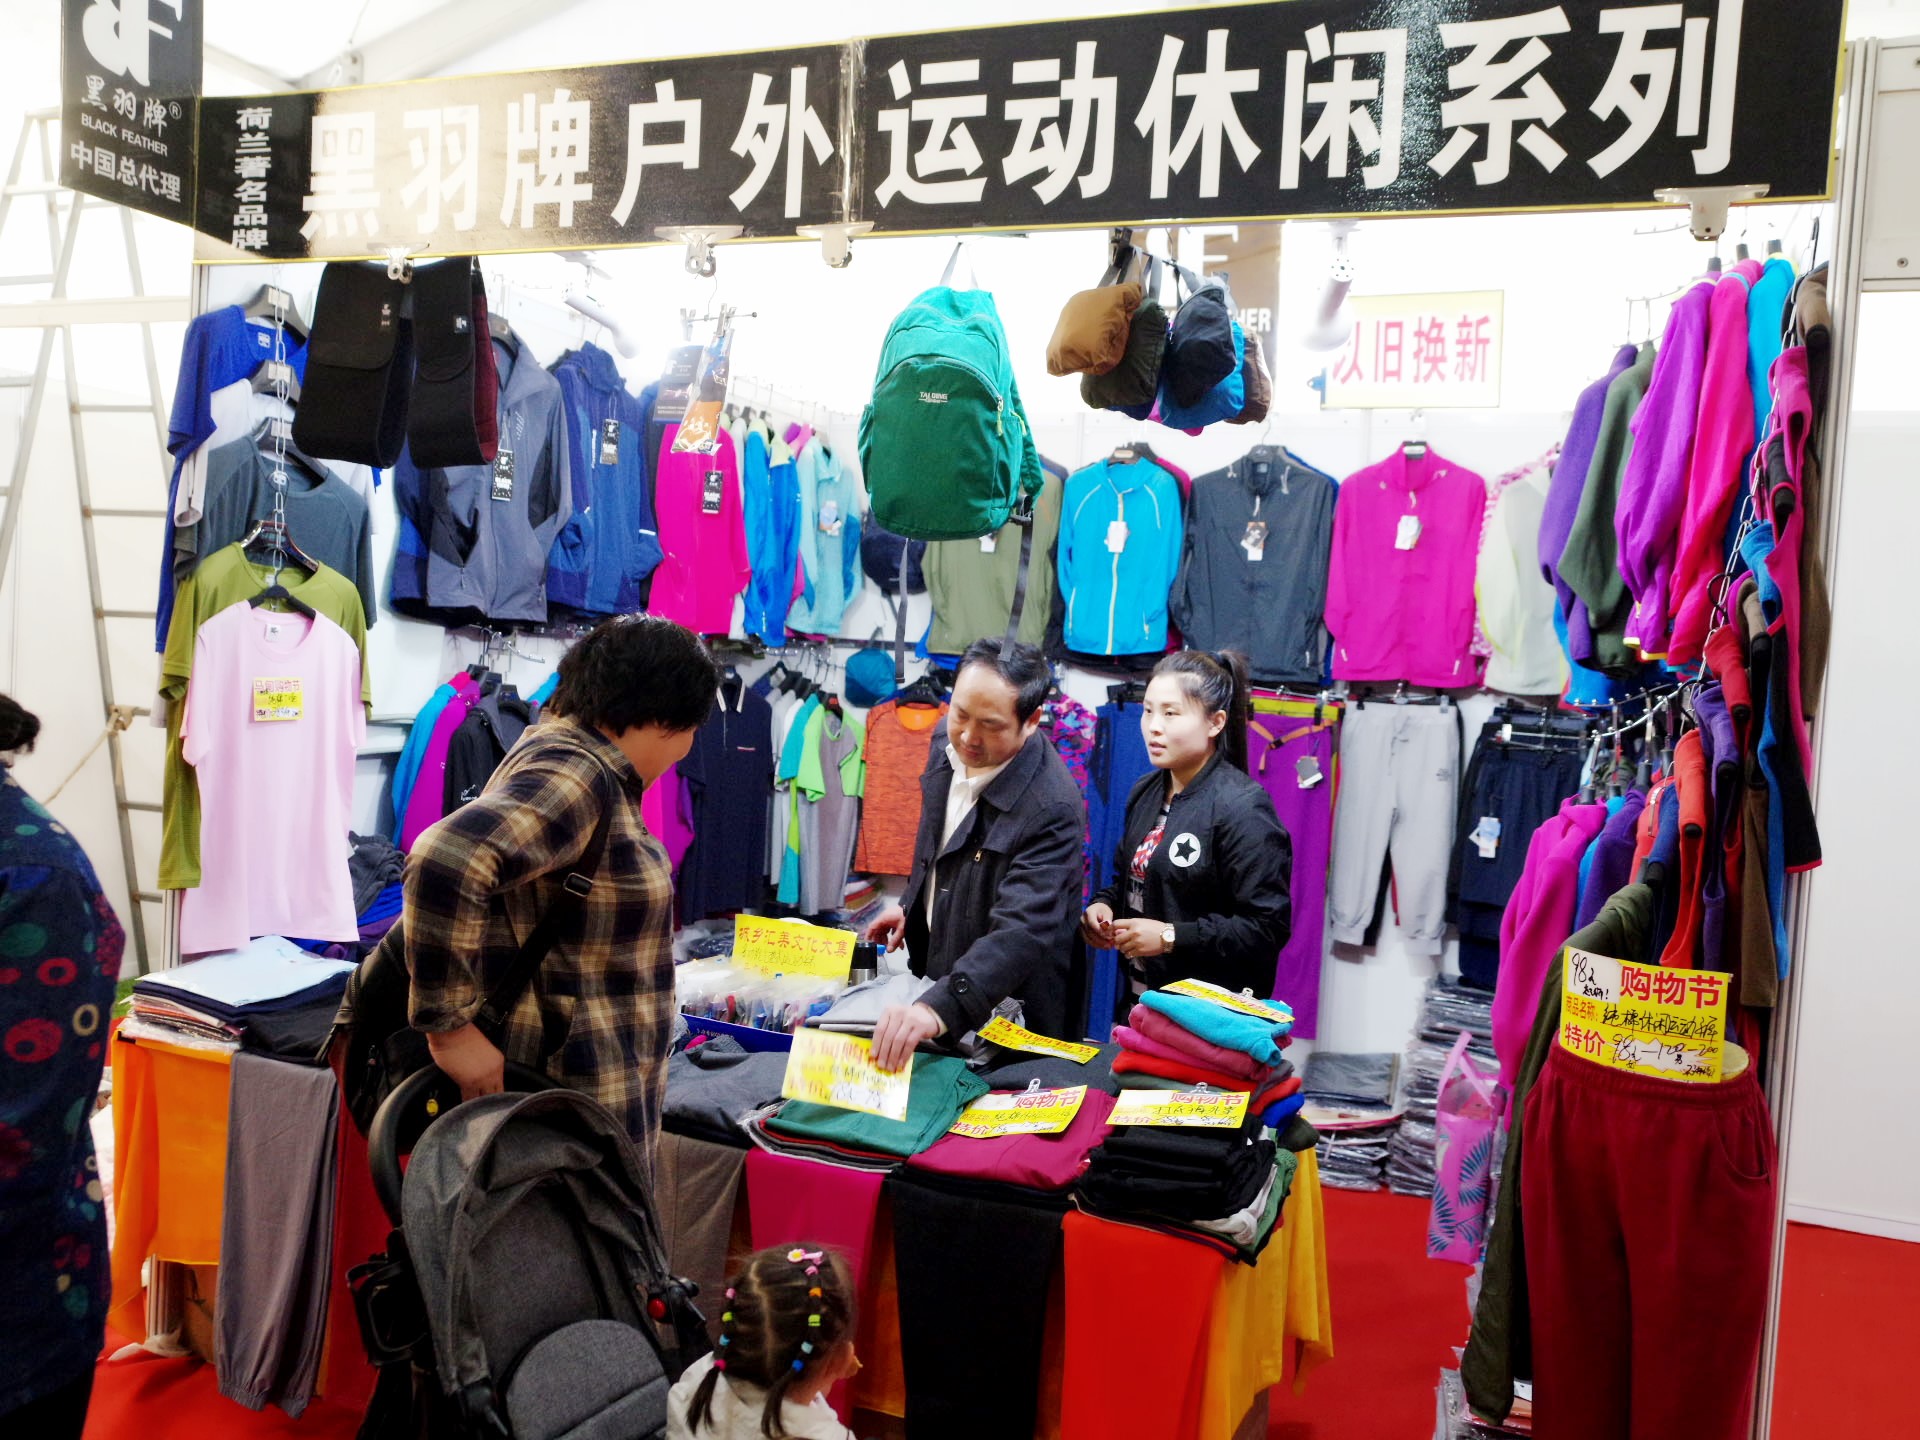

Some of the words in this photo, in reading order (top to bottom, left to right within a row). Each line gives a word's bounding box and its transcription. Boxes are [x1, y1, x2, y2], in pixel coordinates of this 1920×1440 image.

[82, 113, 117, 138] BLACK
[122, 128, 168, 157] FEATHER
[71, 140, 181, 203] 中国总代理
[231, 106, 273, 250] 荷兰著名品牌
[1619, 965, 1723, 1009] 购物节
[1564, 1021, 1605, 1057] 特价
[1014, 1090, 1080, 1109] 购物节
[1170, 1093, 1245, 1106] 购物节
[952, 1121, 989, 1135] 特价
